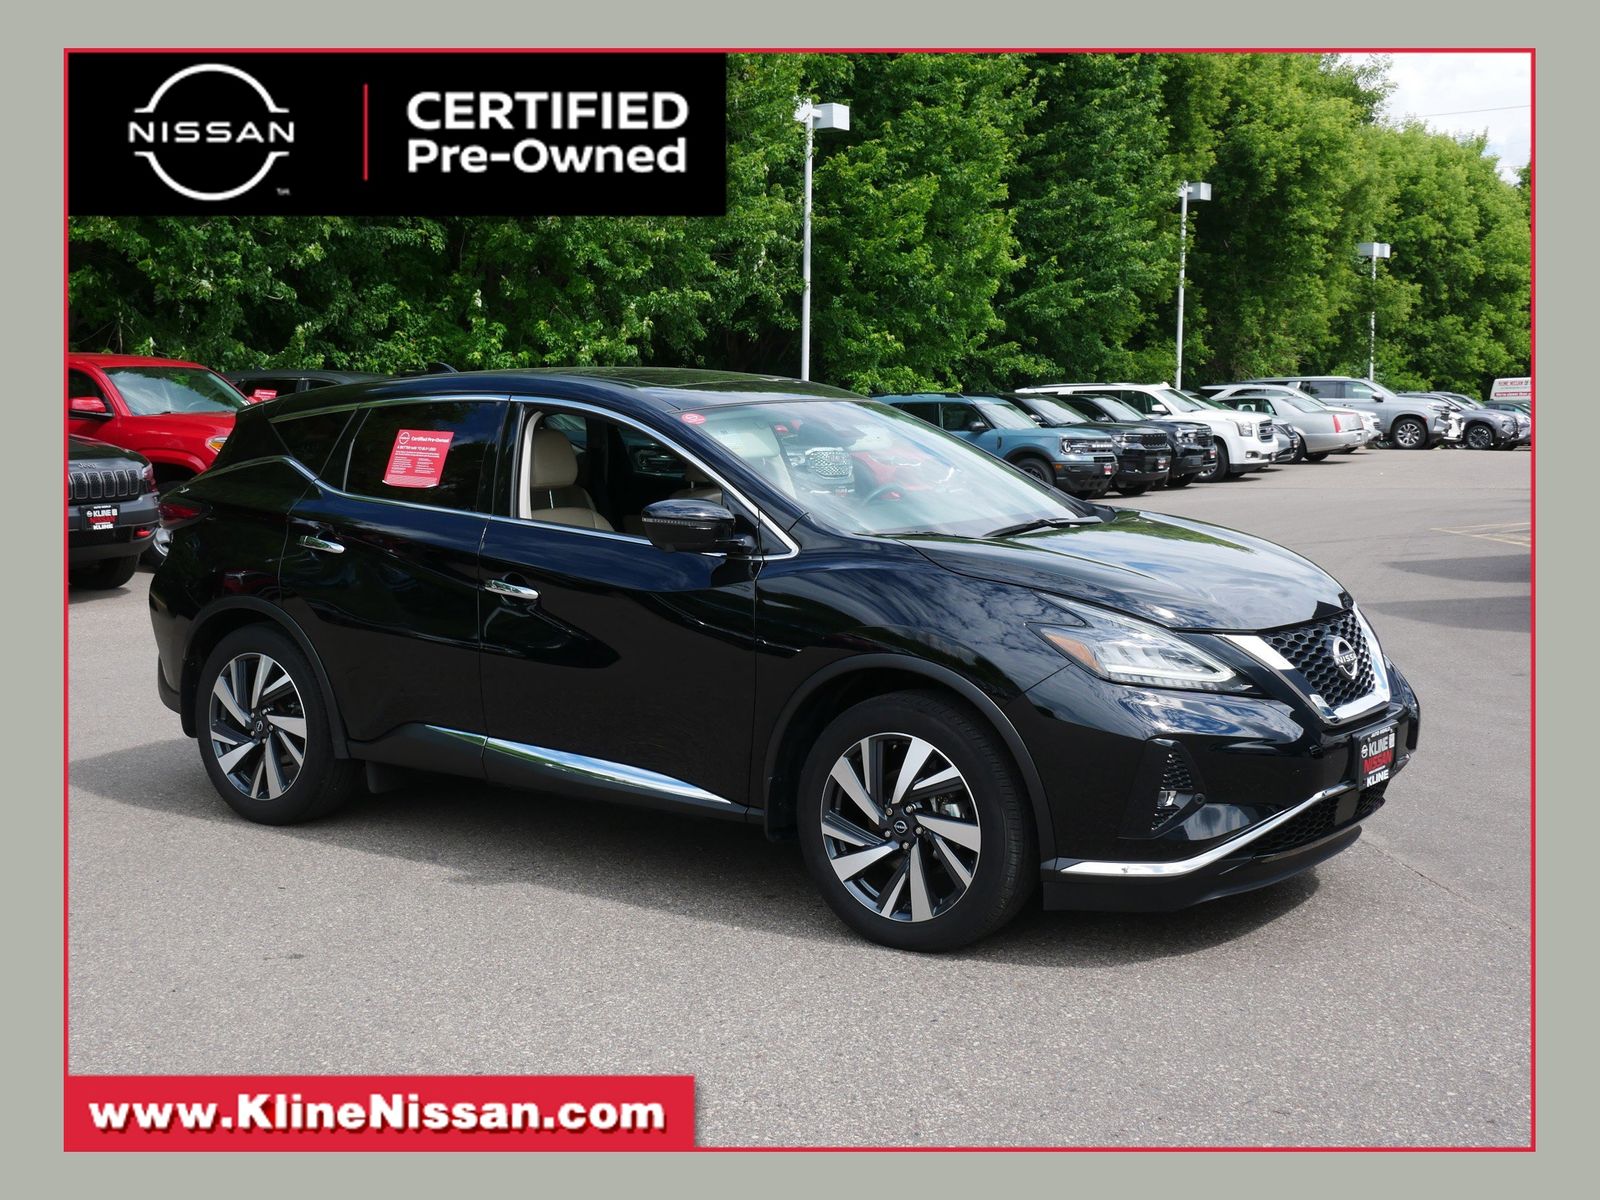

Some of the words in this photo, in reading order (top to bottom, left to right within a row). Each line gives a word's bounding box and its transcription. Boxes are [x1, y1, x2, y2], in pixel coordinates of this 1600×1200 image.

[1368, 736, 1389, 757] KLINE
[1363, 748, 1393, 774] NISSAN
[1366, 769, 1389, 788] KLINE
